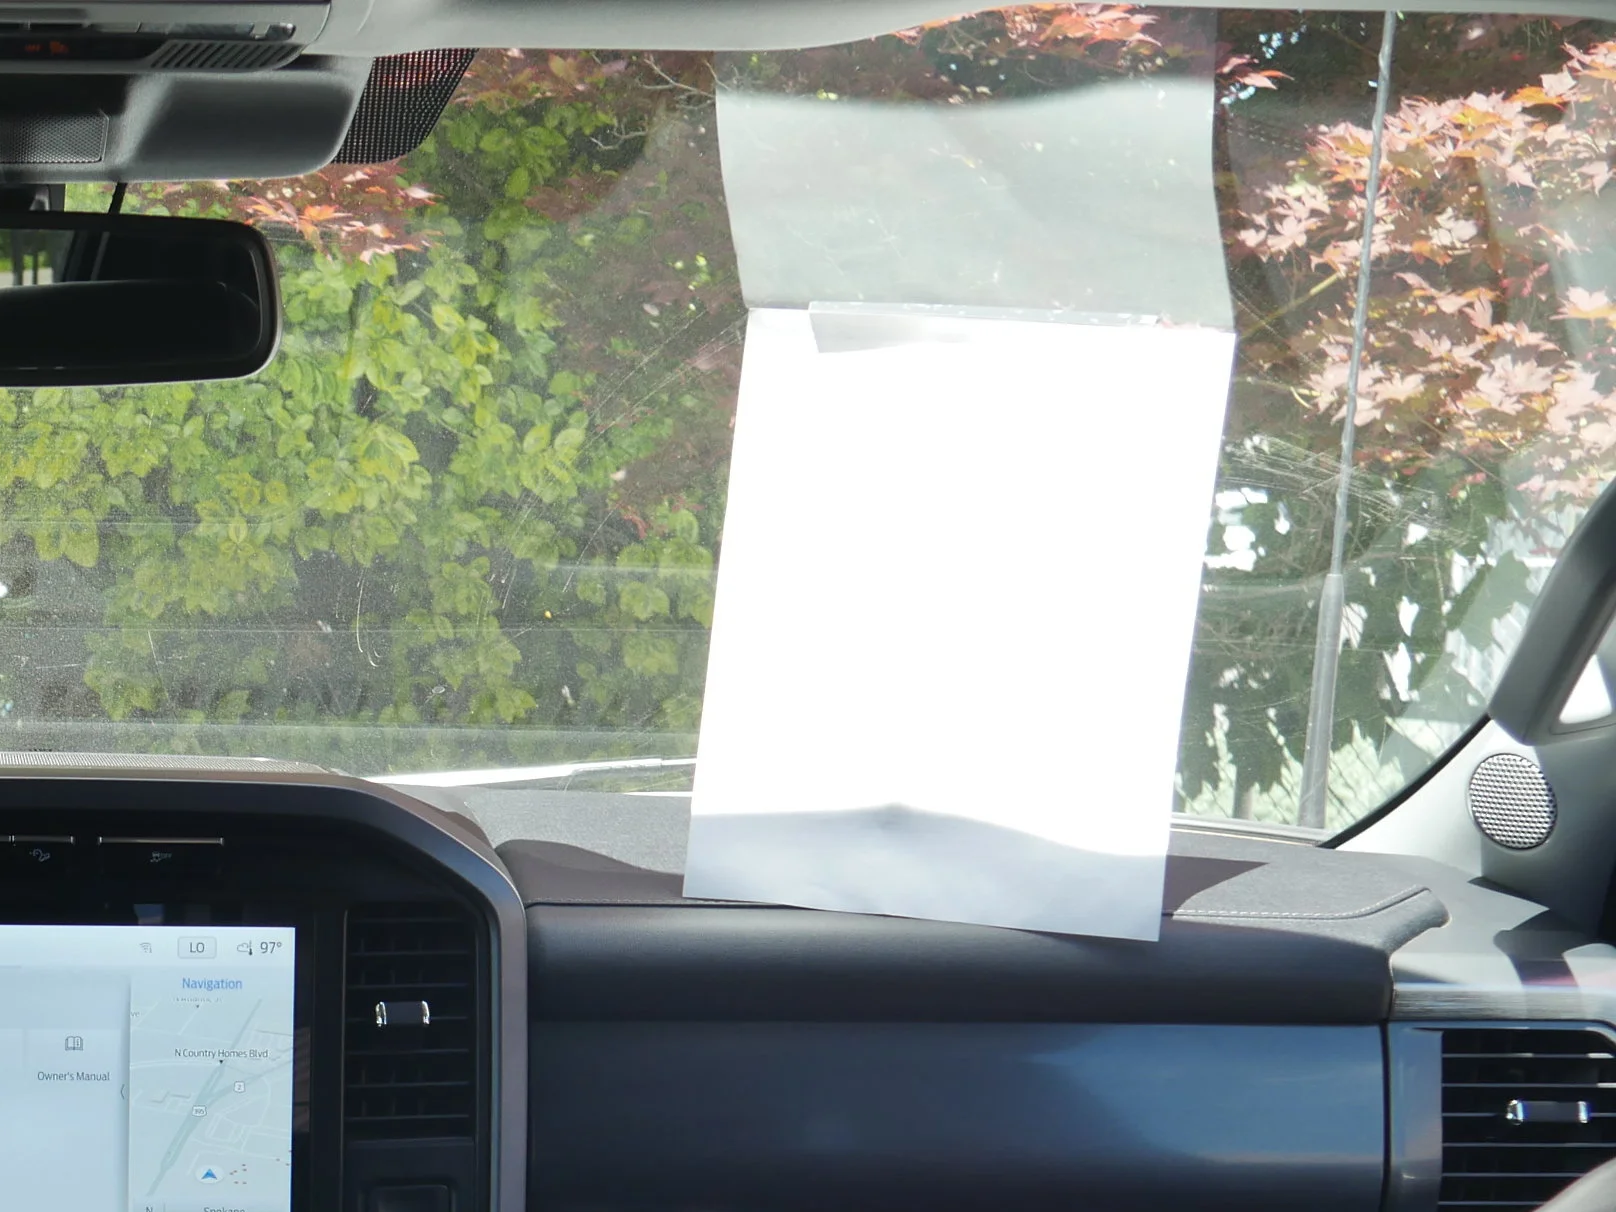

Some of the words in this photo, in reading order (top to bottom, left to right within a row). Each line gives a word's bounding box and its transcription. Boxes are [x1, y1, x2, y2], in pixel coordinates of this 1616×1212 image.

[189, 942, 205, 953] LO
[260, 942, 283, 954] 97°
[182, 978, 243, 991] Navigation
[174, 1049, 181, 1057] N
[183, 1049, 216, 1059] Country
[218, 1049, 247, 1058] Homes
[249, 1050, 269, 1058] Blvd
[37, 1072, 74, 1082] Owner's
[76, 1072, 110, 1082] Manual
